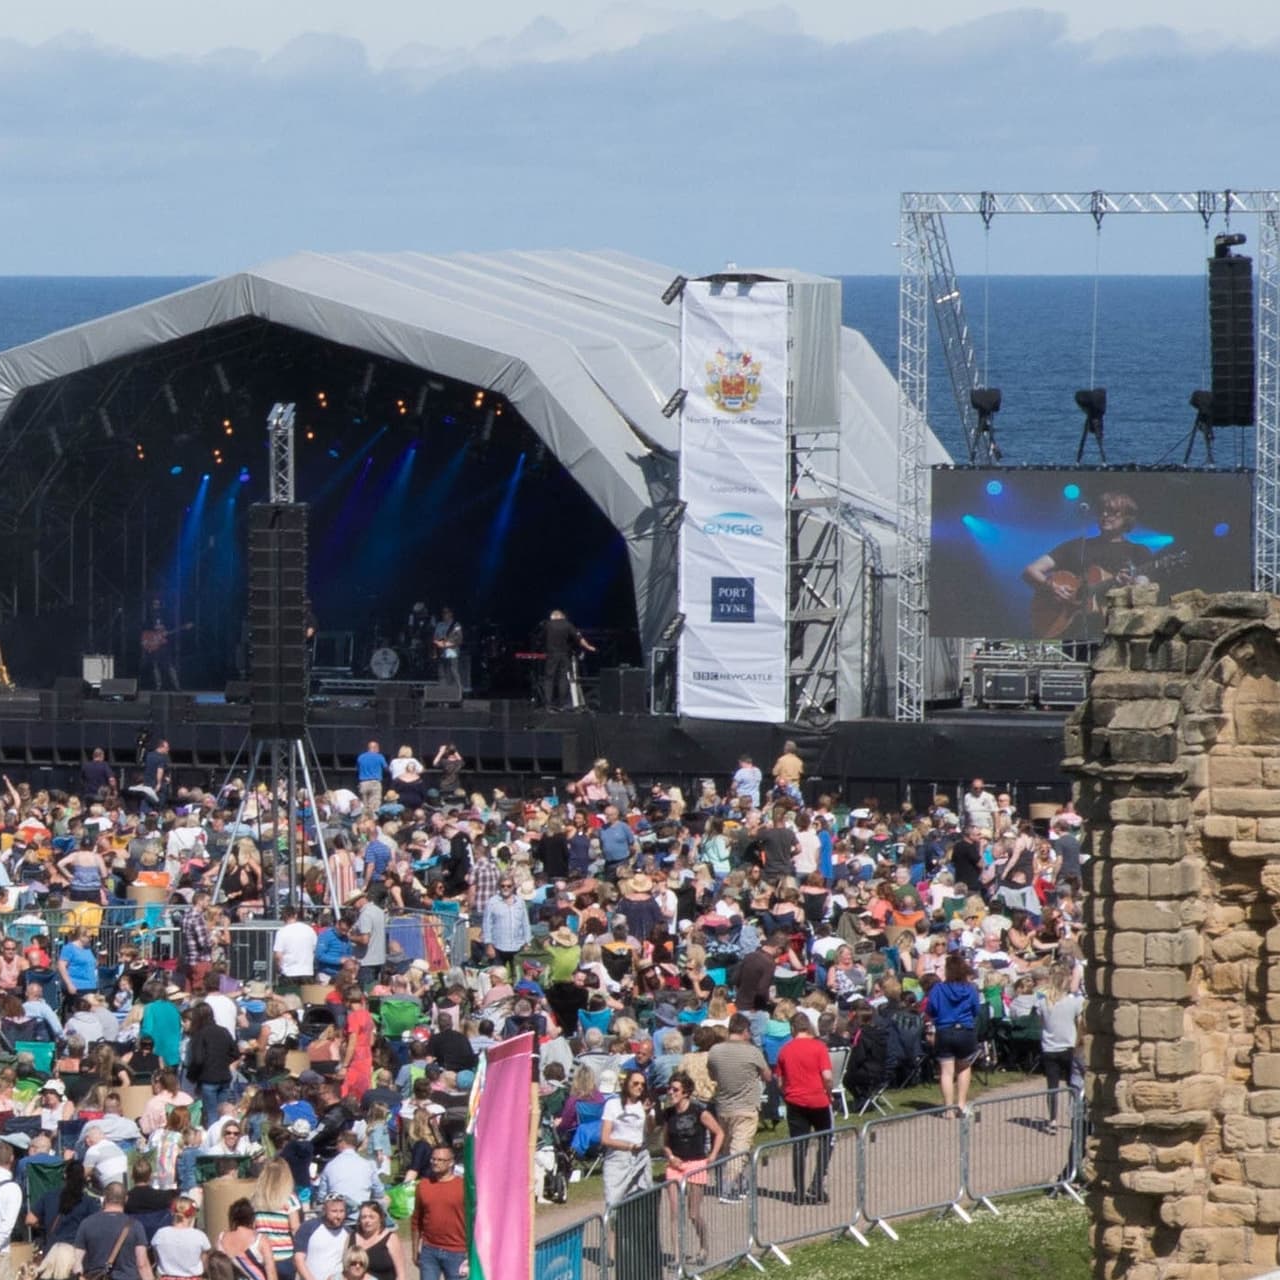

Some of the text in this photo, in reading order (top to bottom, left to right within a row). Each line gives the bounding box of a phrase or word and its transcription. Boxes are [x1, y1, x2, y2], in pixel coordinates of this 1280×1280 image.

[718, 587, 748, 598] PORT
[719, 603, 749, 614] TYNE
[720, 672, 773, 682] NEWCASTLE
